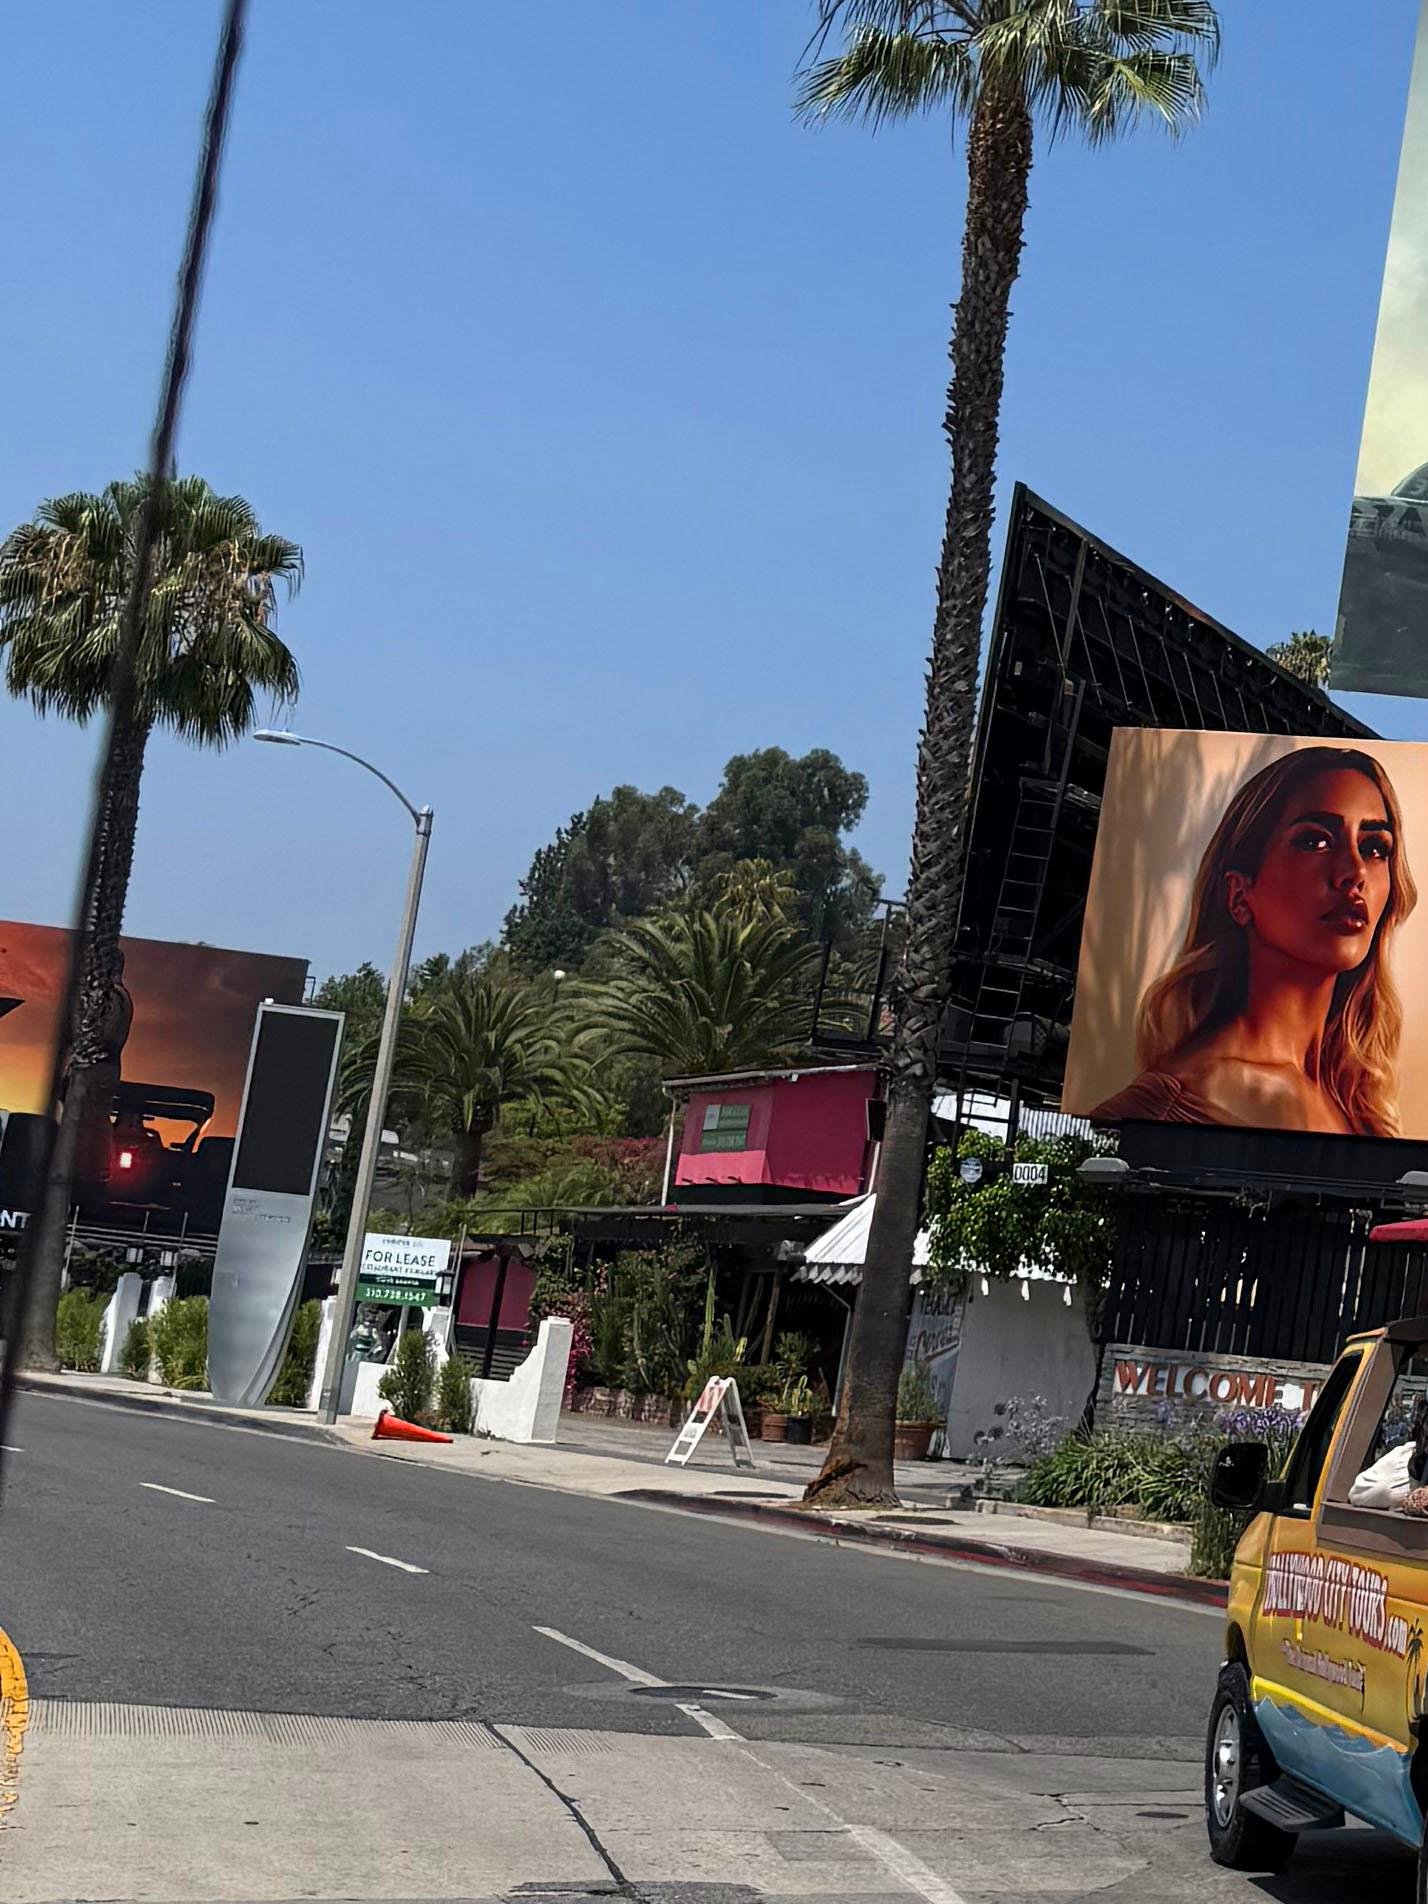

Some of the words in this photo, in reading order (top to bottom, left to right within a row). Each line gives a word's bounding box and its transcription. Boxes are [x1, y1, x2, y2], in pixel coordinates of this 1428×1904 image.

[1014, 1165, 1047, 1181] 0004
[366, 1249, 392, 1264] FOR
[396, 1253, 436, 1267] LEASE
[1115, 1360, 1284, 1409] WELCOME
